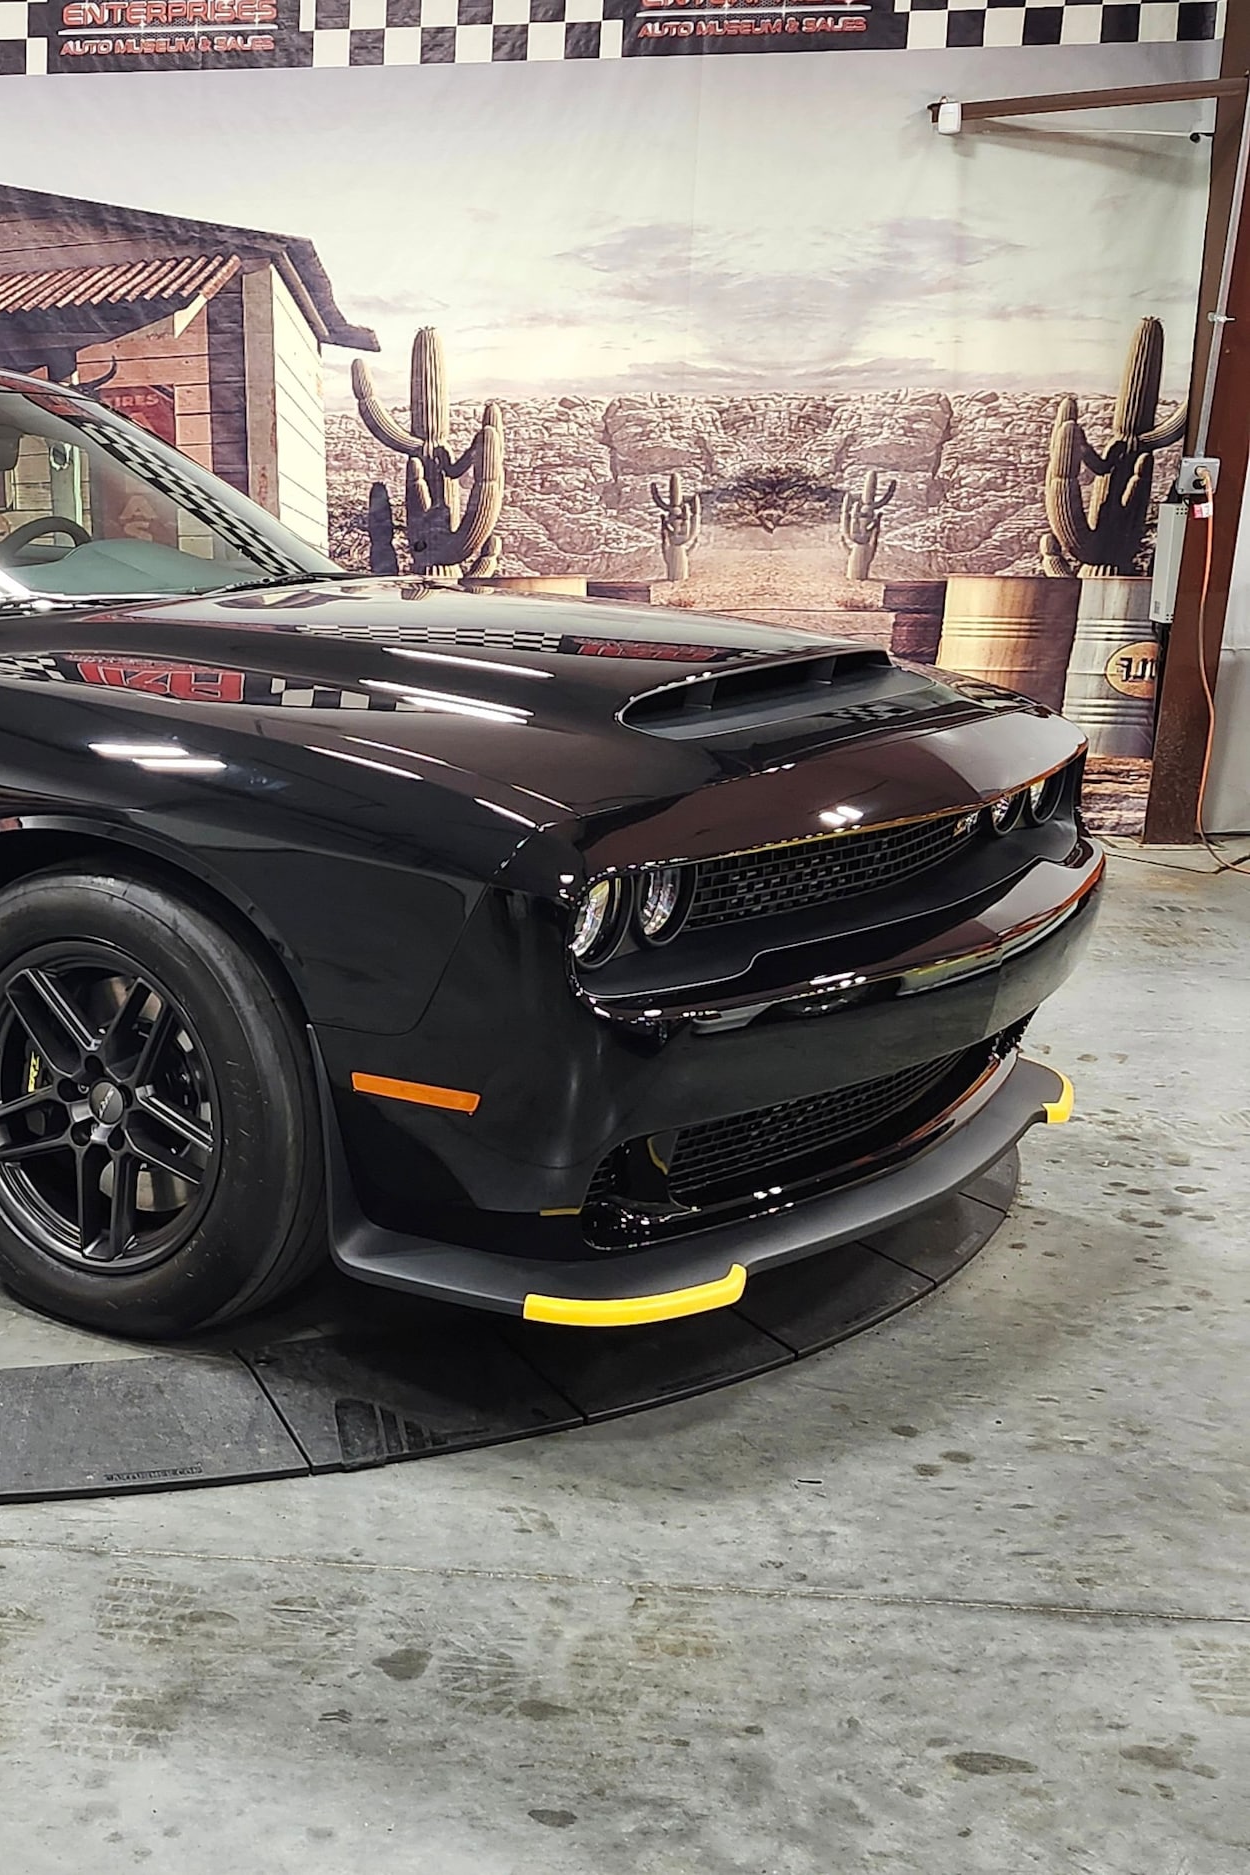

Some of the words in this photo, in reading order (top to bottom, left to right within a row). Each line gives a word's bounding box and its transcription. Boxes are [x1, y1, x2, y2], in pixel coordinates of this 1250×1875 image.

[62, 0, 278, 26] ENTERPRISES
[636, 21, 695, 38] AUTO
[695, 19, 783, 36] MUSEUM
[784, 18, 800, 34] &
[801, 16, 868, 33] SALES
[59, 40, 113, 56] AUTO
[114, 38, 196, 54] MUSEUM
[198, 36, 212, 52] &
[213, 35, 275, 51] SALES
